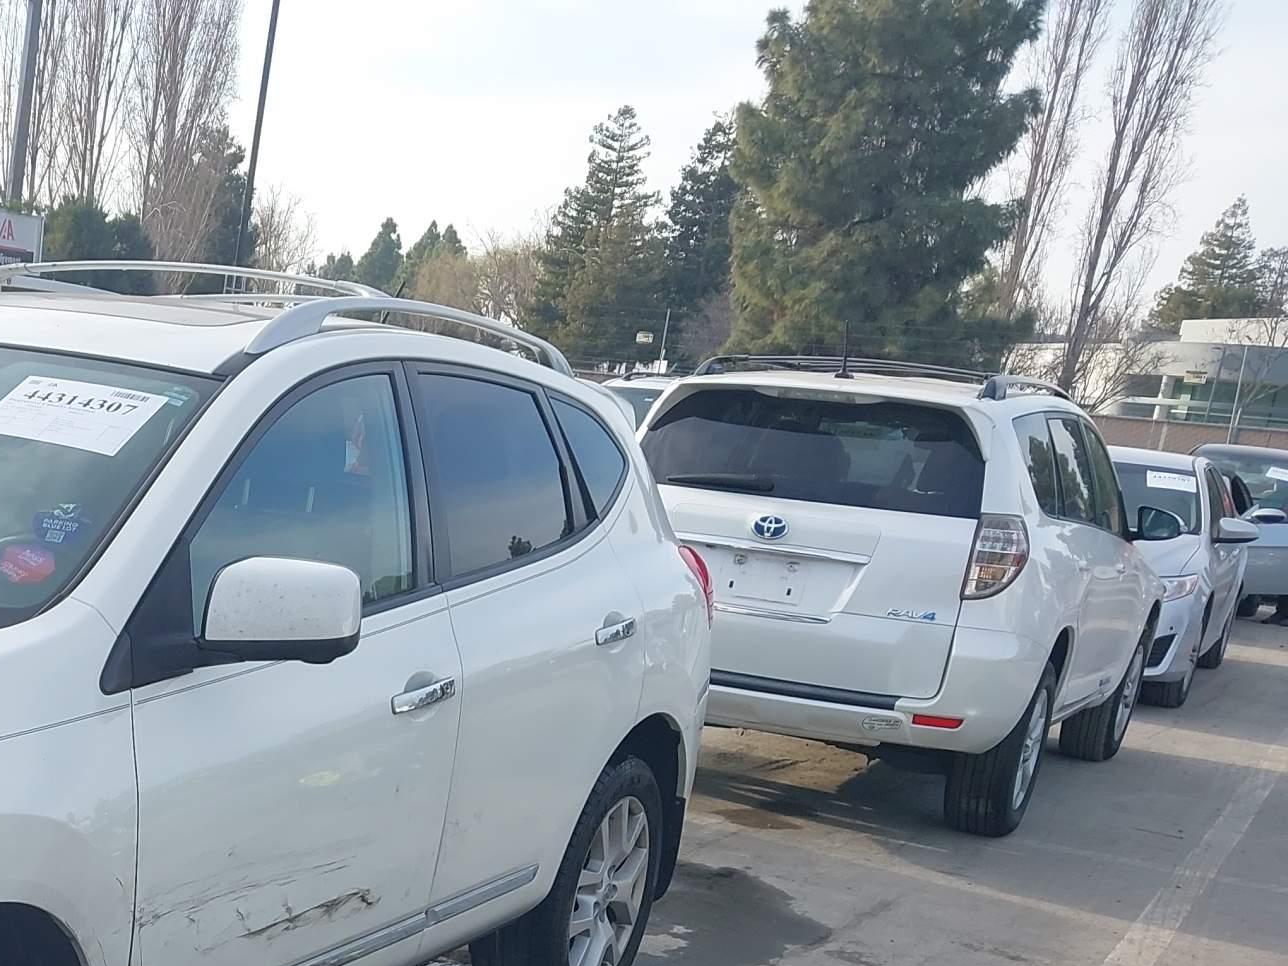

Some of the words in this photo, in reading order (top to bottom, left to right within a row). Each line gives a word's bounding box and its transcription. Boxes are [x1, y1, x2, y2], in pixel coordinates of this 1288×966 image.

[23, 389, 139, 416] 44314307
[43, 518, 79, 529] PARKING
[886, 608, 937, 621] RAV4
